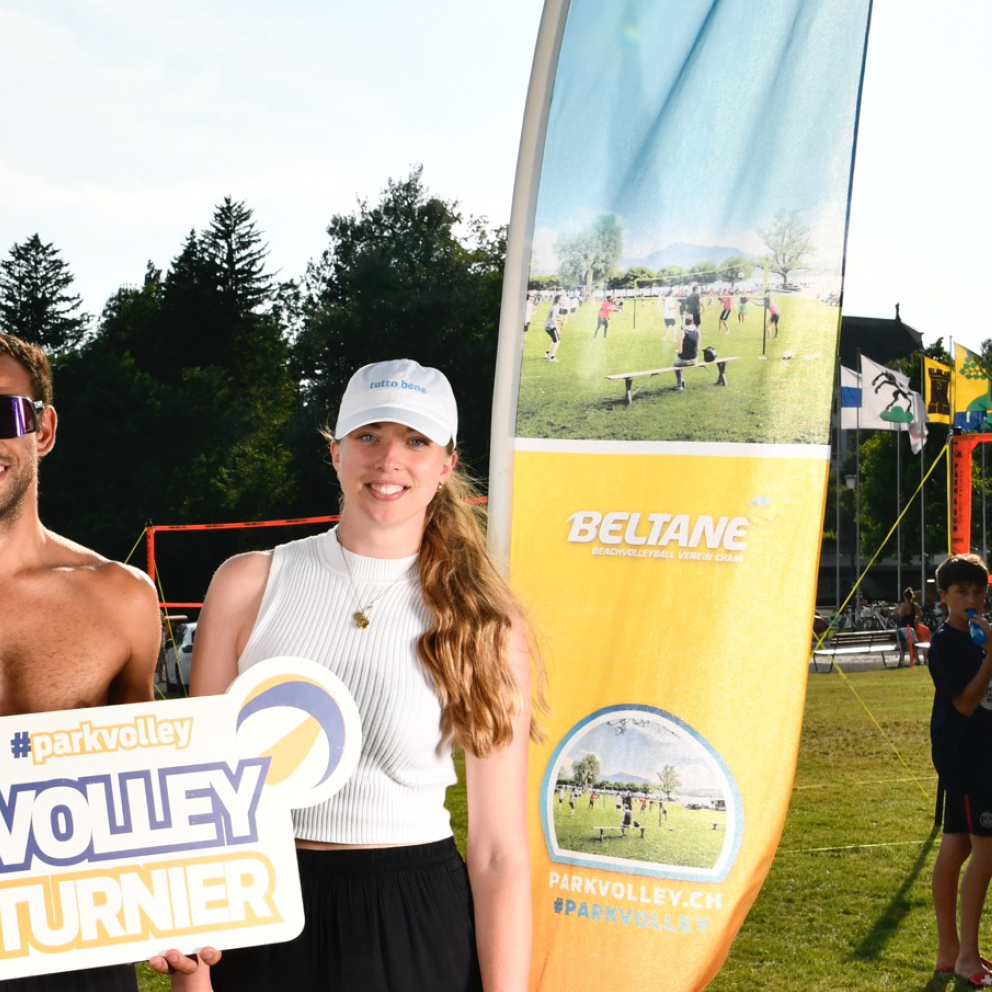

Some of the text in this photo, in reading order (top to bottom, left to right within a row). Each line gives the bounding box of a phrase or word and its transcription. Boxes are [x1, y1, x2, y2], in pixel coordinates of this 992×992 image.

[369, 379, 427, 394] tutto bene
[564, 511, 752, 551] BELTANE
[591, 547, 745, 563] BEACHVOLLEYBALL VEREIN CHAM
[10, 715, 193, 764] #parkvolley
[548, 871, 722, 910] PARKVOLLEY.CH
[553, 897, 710, 933] #PARKVOLLEY
